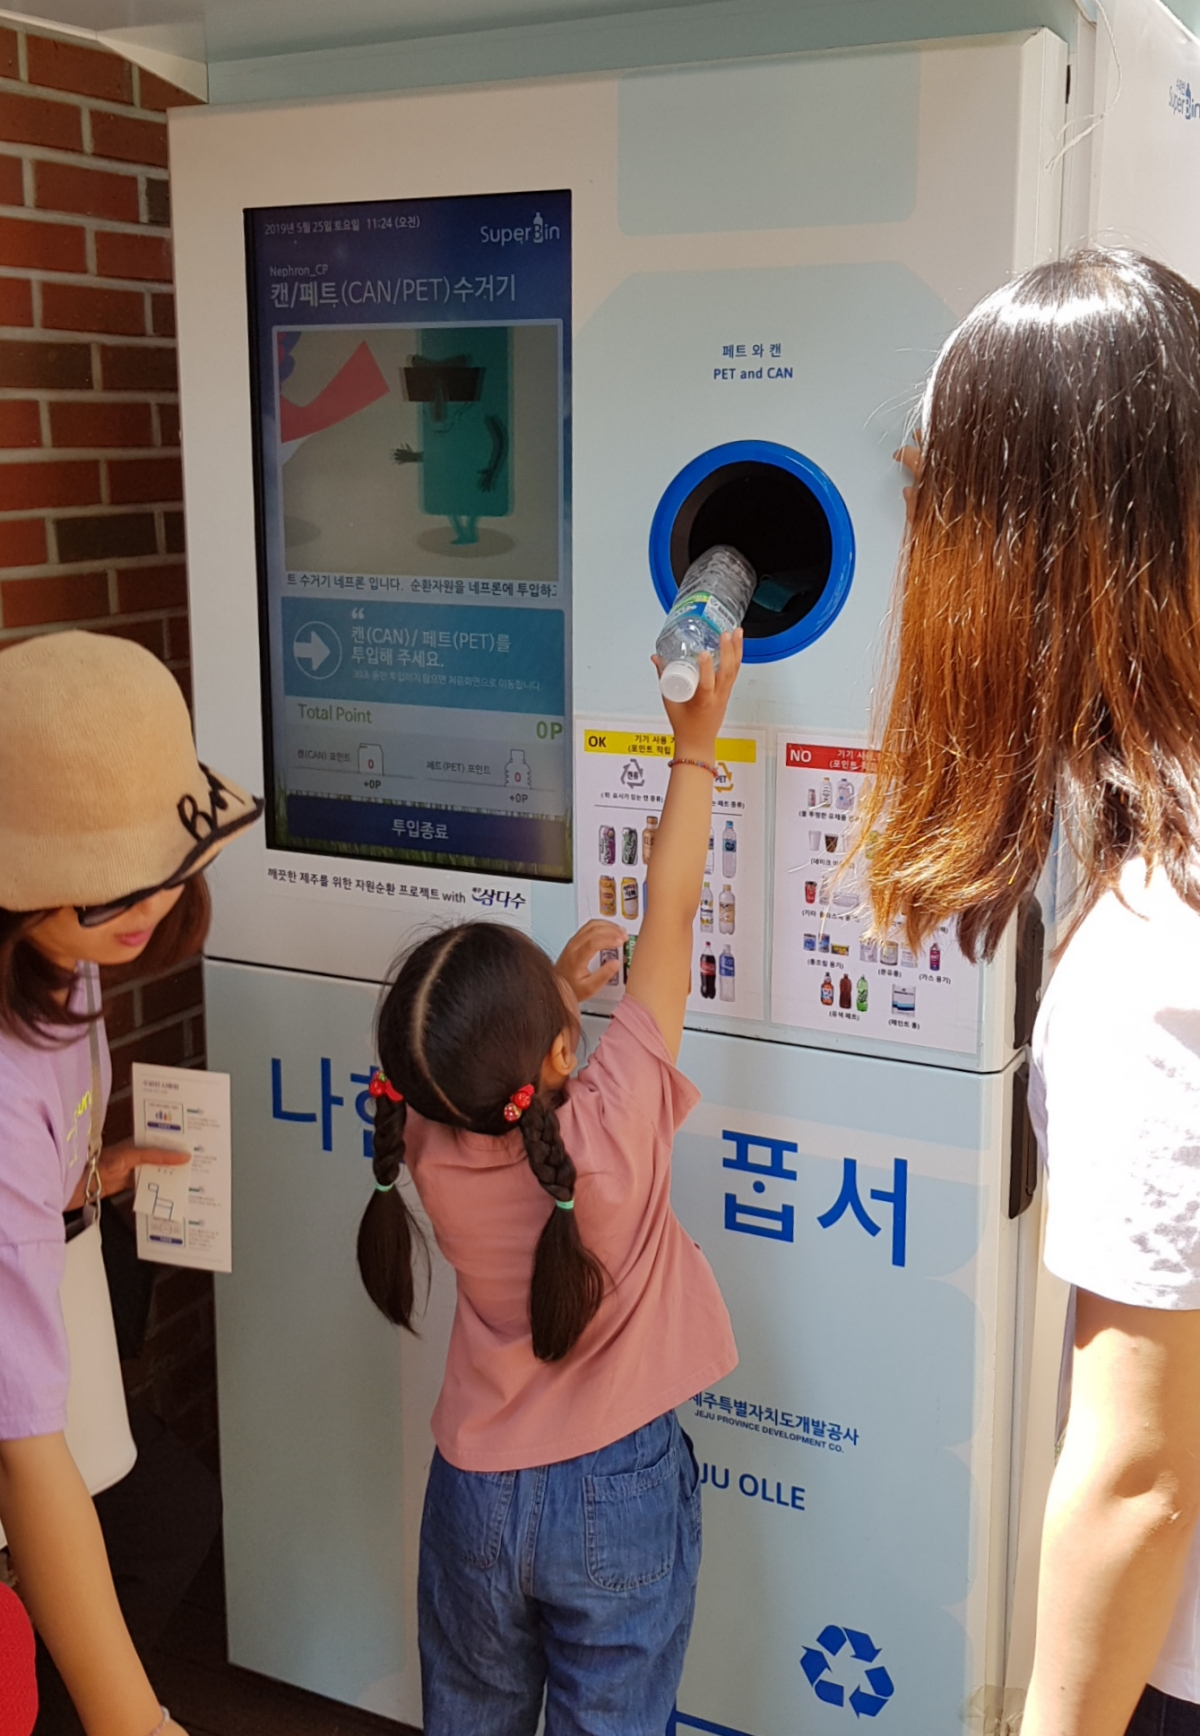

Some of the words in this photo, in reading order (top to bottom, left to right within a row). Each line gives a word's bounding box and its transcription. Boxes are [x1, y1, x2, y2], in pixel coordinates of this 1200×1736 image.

[264, 222, 295, 235] 2019년
[296, 221, 311, 234] 5월
[312, 220, 332, 233] 25일
[334, 219, 360, 232] 토요일
[367, 217, 392, 230] 11:24
[395, 215, 421, 230] (오전)
[480, 212, 560, 246] SuperBin
[269, 263, 329, 278] Nephron_CP
[270, 274, 516, 309] 캔/페트(CAN/PET)수거기
[722, 344, 748, 359] 페트
[752, 343, 765, 358] 와
[769, 342, 781, 358] 캔
[713, 368, 736, 380] PET
[740, 367, 763, 380] and
[767, 367, 794, 379] CAN
[287, 575, 298, 586] 트
[300, 574, 331, 589] 수거기
[334, 576, 366, 591] 네프론
[369, 577, 404, 592] 입니다.
[410, 578, 465, 595] 순환자원을
[468, 581, 514, 597] 네프론에
[350, 625, 419, 647] 캔(CAN)/
[422, 630, 512, 654] 페트(PET)를
[351, 646, 394, 666] 투입해
[397, 650, 445, 669] 주세요.
[297, 703, 333, 722] Total
[335, 707, 372, 725] Point
[535, 720, 564, 741] 0P
[588, 735, 607, 748] OK
[635, 735, 650, 744] 기기
[652, 735, 667, 745] 사용
[628, 744, 653, 754] (포인트
[657, 745, 671, 755] 적립
[790, 749, 812, 763] NO
[837, 749, 854, 760] 기기
[329, 752, 352, 763] 포인트
[367, 759, 375, 770] 0
[829, 760, 858, 770] (포인트
[426, 760, 466, 774] 페트(PET)
[468, 763, 492, 775] 포인트
[363, 779, 382, 790] +0P
[514, 772, 522, 783] 0
[715, 775, 727, 783] PET
[510, 793, 529, 804] +0P
[391, 818, 449, 841] 투입종료
[267, 868, 297, 884] 깨끗한
[299, 872, 329, 888] 제주를
[332, 876, 352, 891] 위한
[355, 879, 396, 896] 자원순환
[399, 884, 440, 901] 프로젝트
[442, 891, 466, 904] with
[479, 888, 527, 910] 삼다수
[918, 973, 935, 982] (가스
[688, 1391, 860, 1446] 제주특별자치도개발공사
[694, 1408, 716, 1421] JEJU
[717, 1413, 760, 1433] PROVINCE
[762, 1425, 827, 1449] DEVELOPMENT
[828, 1442, 845, 1454] CO.
[700, 1462, 730, 1490] JU
[738, 1473, 806, 1511] OLLE
